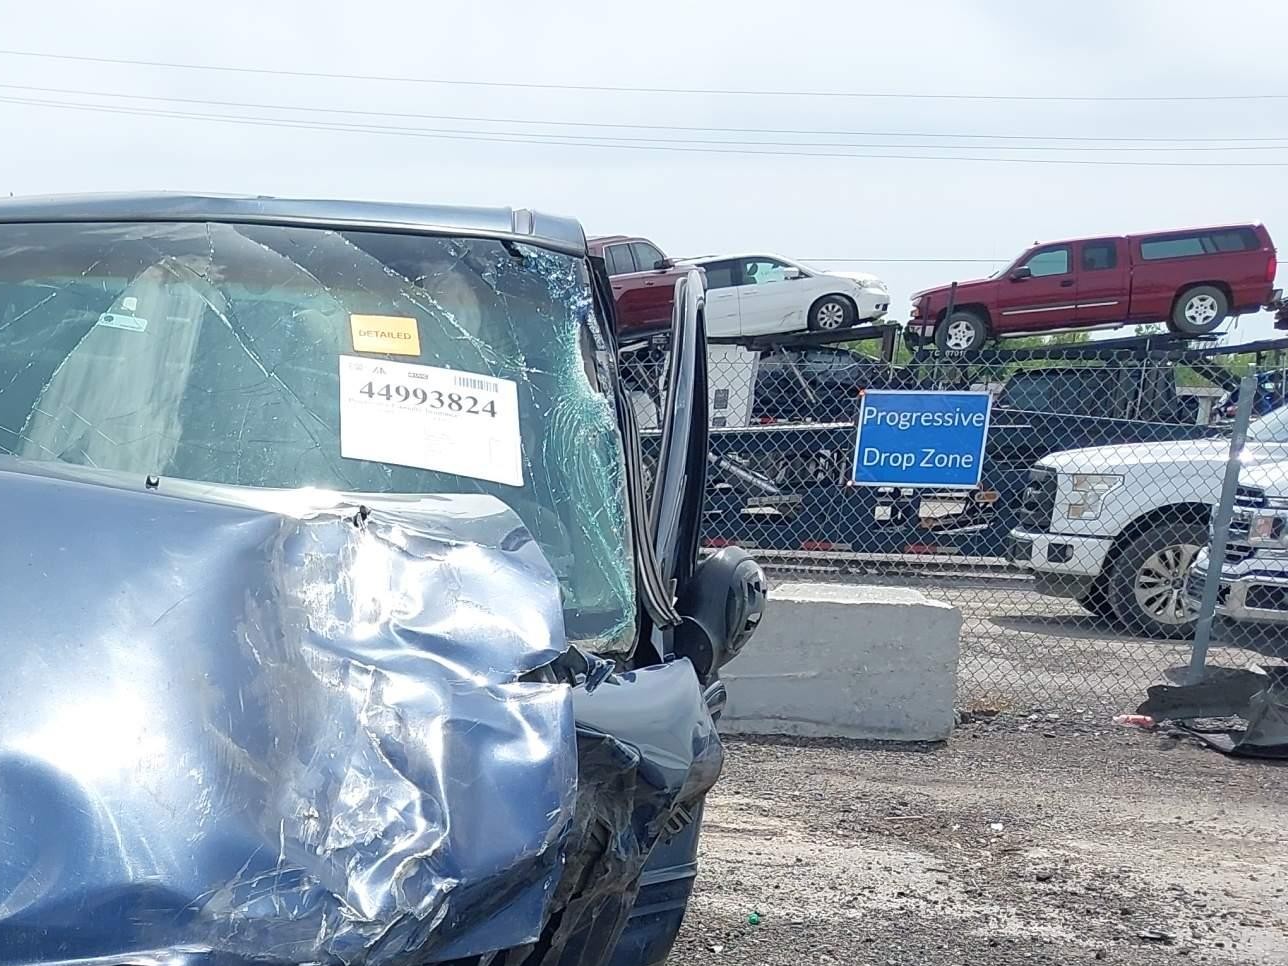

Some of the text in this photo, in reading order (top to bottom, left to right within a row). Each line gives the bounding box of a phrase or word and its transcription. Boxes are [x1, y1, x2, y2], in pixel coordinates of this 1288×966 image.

[359, 330, 412, 340] DETAILED
[360, 381, 498, 418] 44993824
[863, 407, 985, 430] Progressive
[863, 448, 974, 470] Drop Zone
